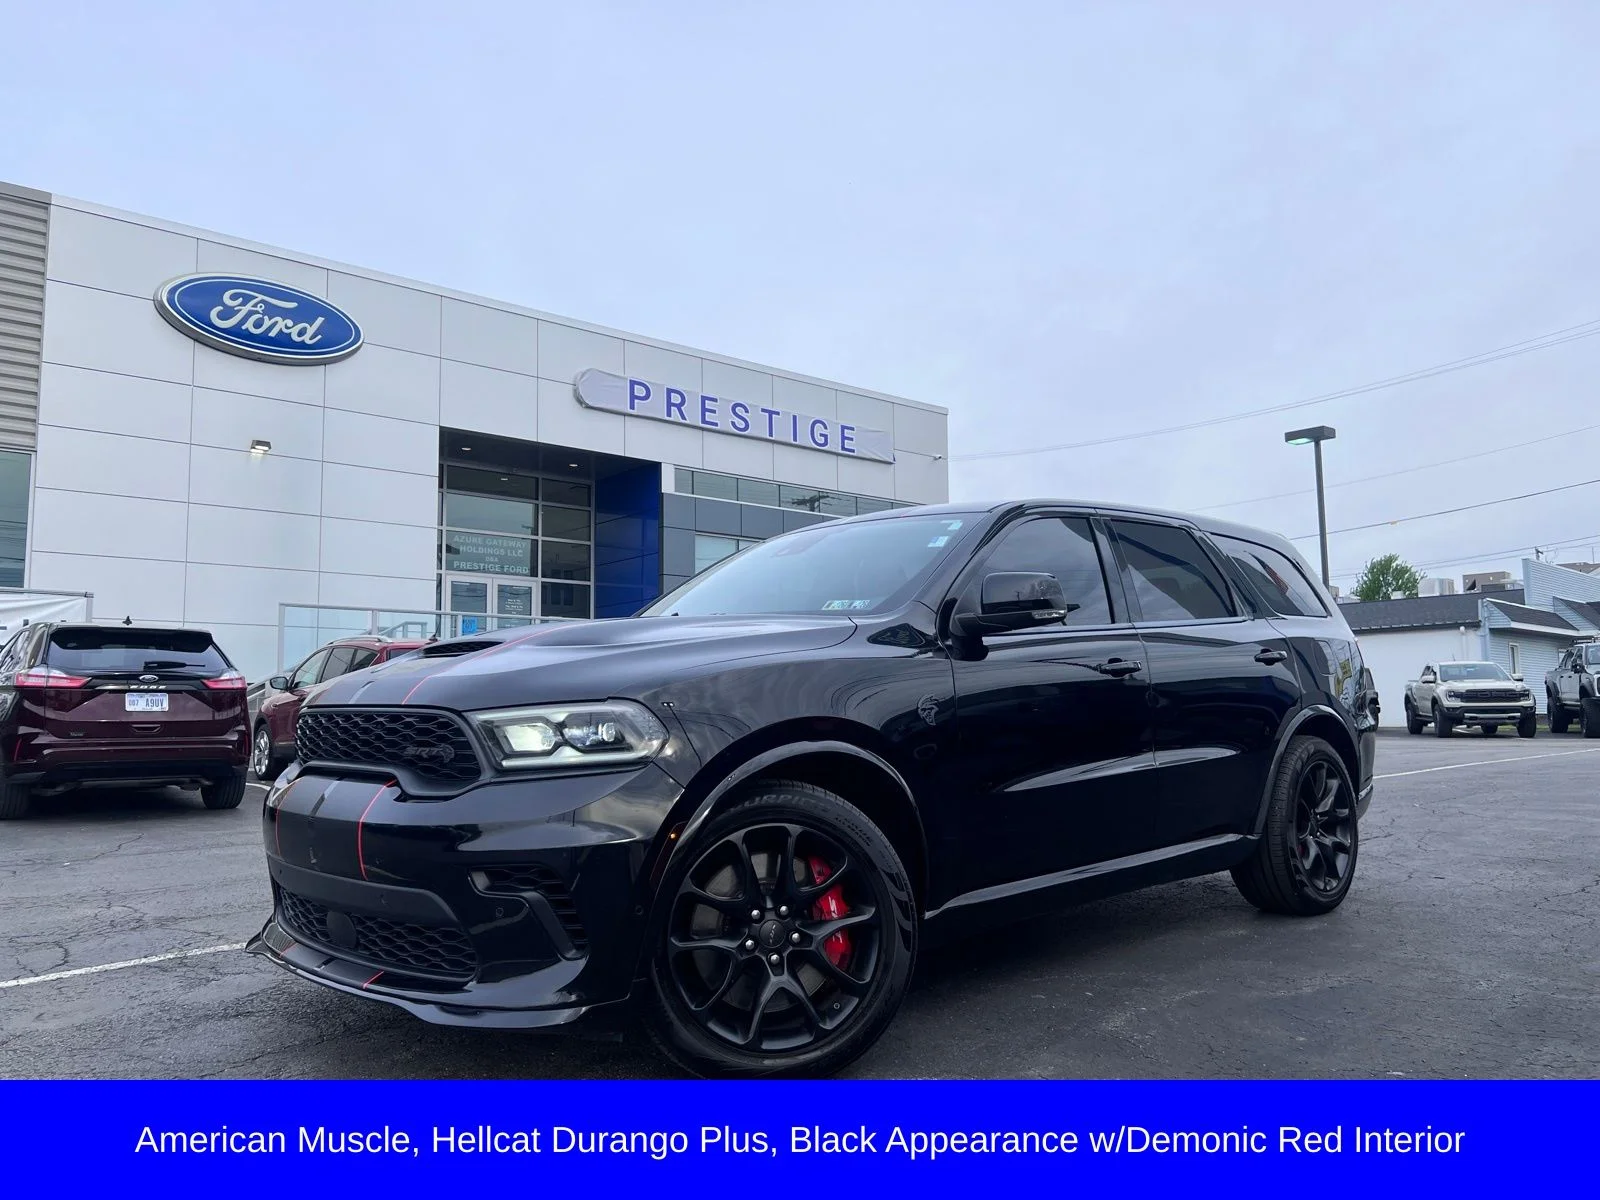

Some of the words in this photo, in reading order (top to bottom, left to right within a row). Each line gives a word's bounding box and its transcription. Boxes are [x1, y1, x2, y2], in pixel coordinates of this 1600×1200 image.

[209, 288, 325, 345] Ford
[628, 378, 856, 454] PRESTIGE
[453, 535, 484, 545] AZURE
[486, 538, 527, 549] GATEWAY
[459, 545, 505, 556] HOLDINGS
[507, 549, 524, 557] LLC
[453, 560, 502, 572] PRESTIGE
[504, 564, 529, 574] FORD
